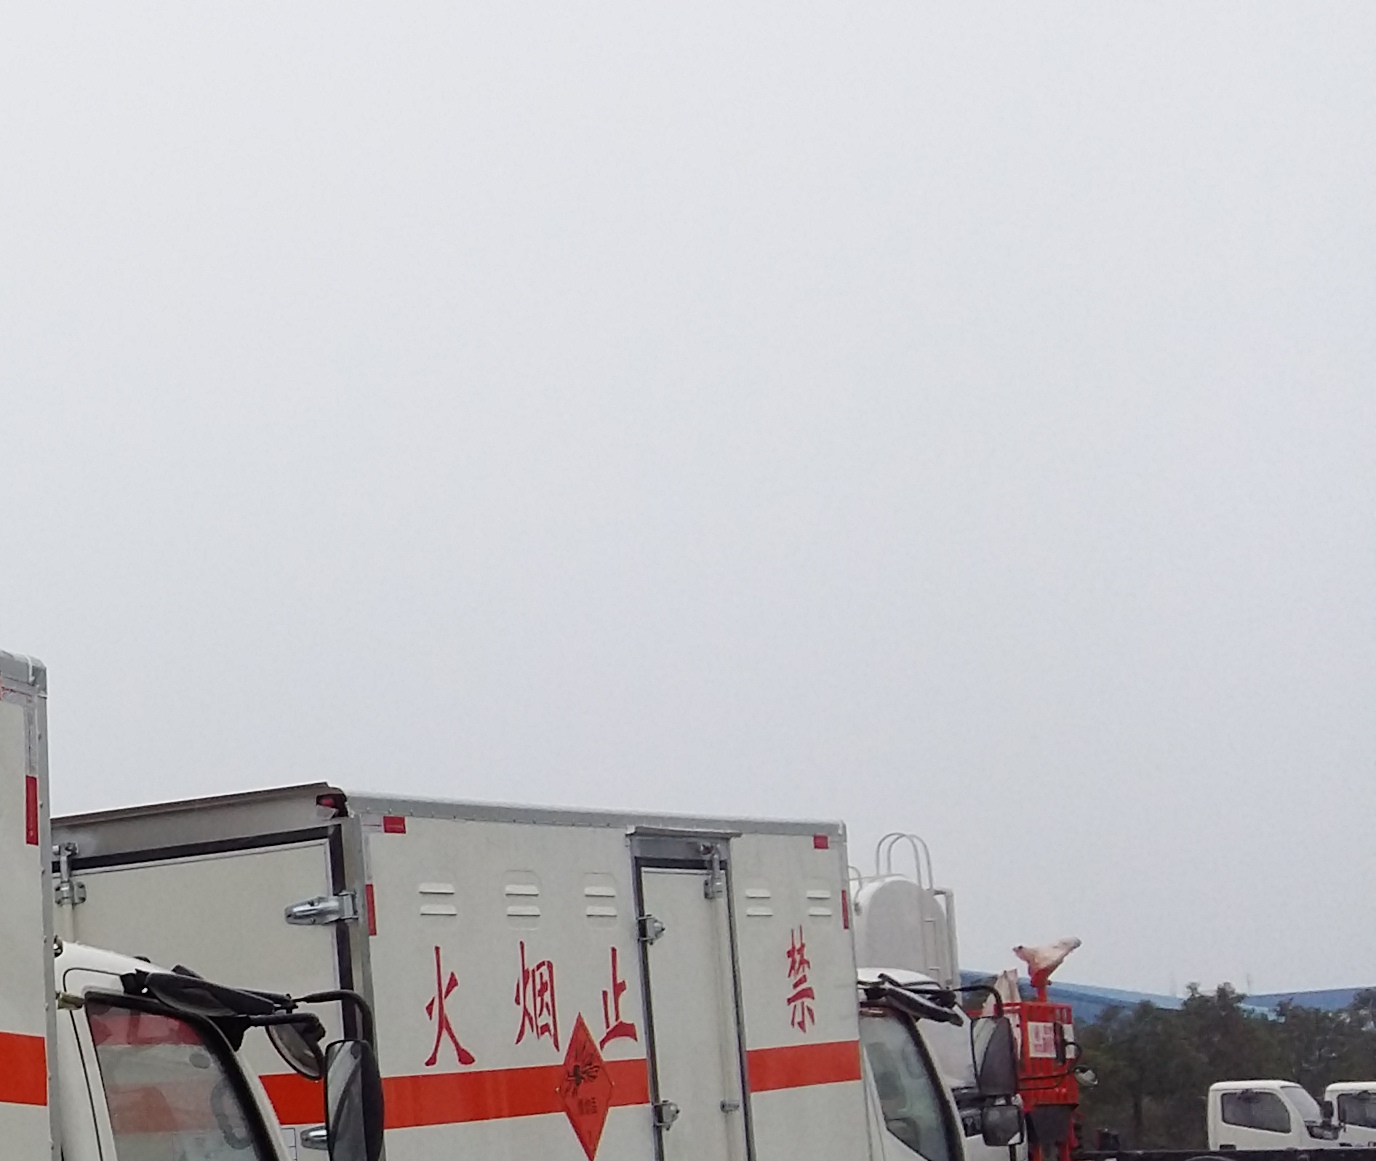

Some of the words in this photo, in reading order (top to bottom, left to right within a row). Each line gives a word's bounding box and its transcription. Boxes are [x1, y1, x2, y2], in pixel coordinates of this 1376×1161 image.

[424, 945, 476, 1067] 火
[514, 940, 561, 1053] 烟
[599, 946, 639, 1051] 止
[786, 923, 816, 1034] 禁
